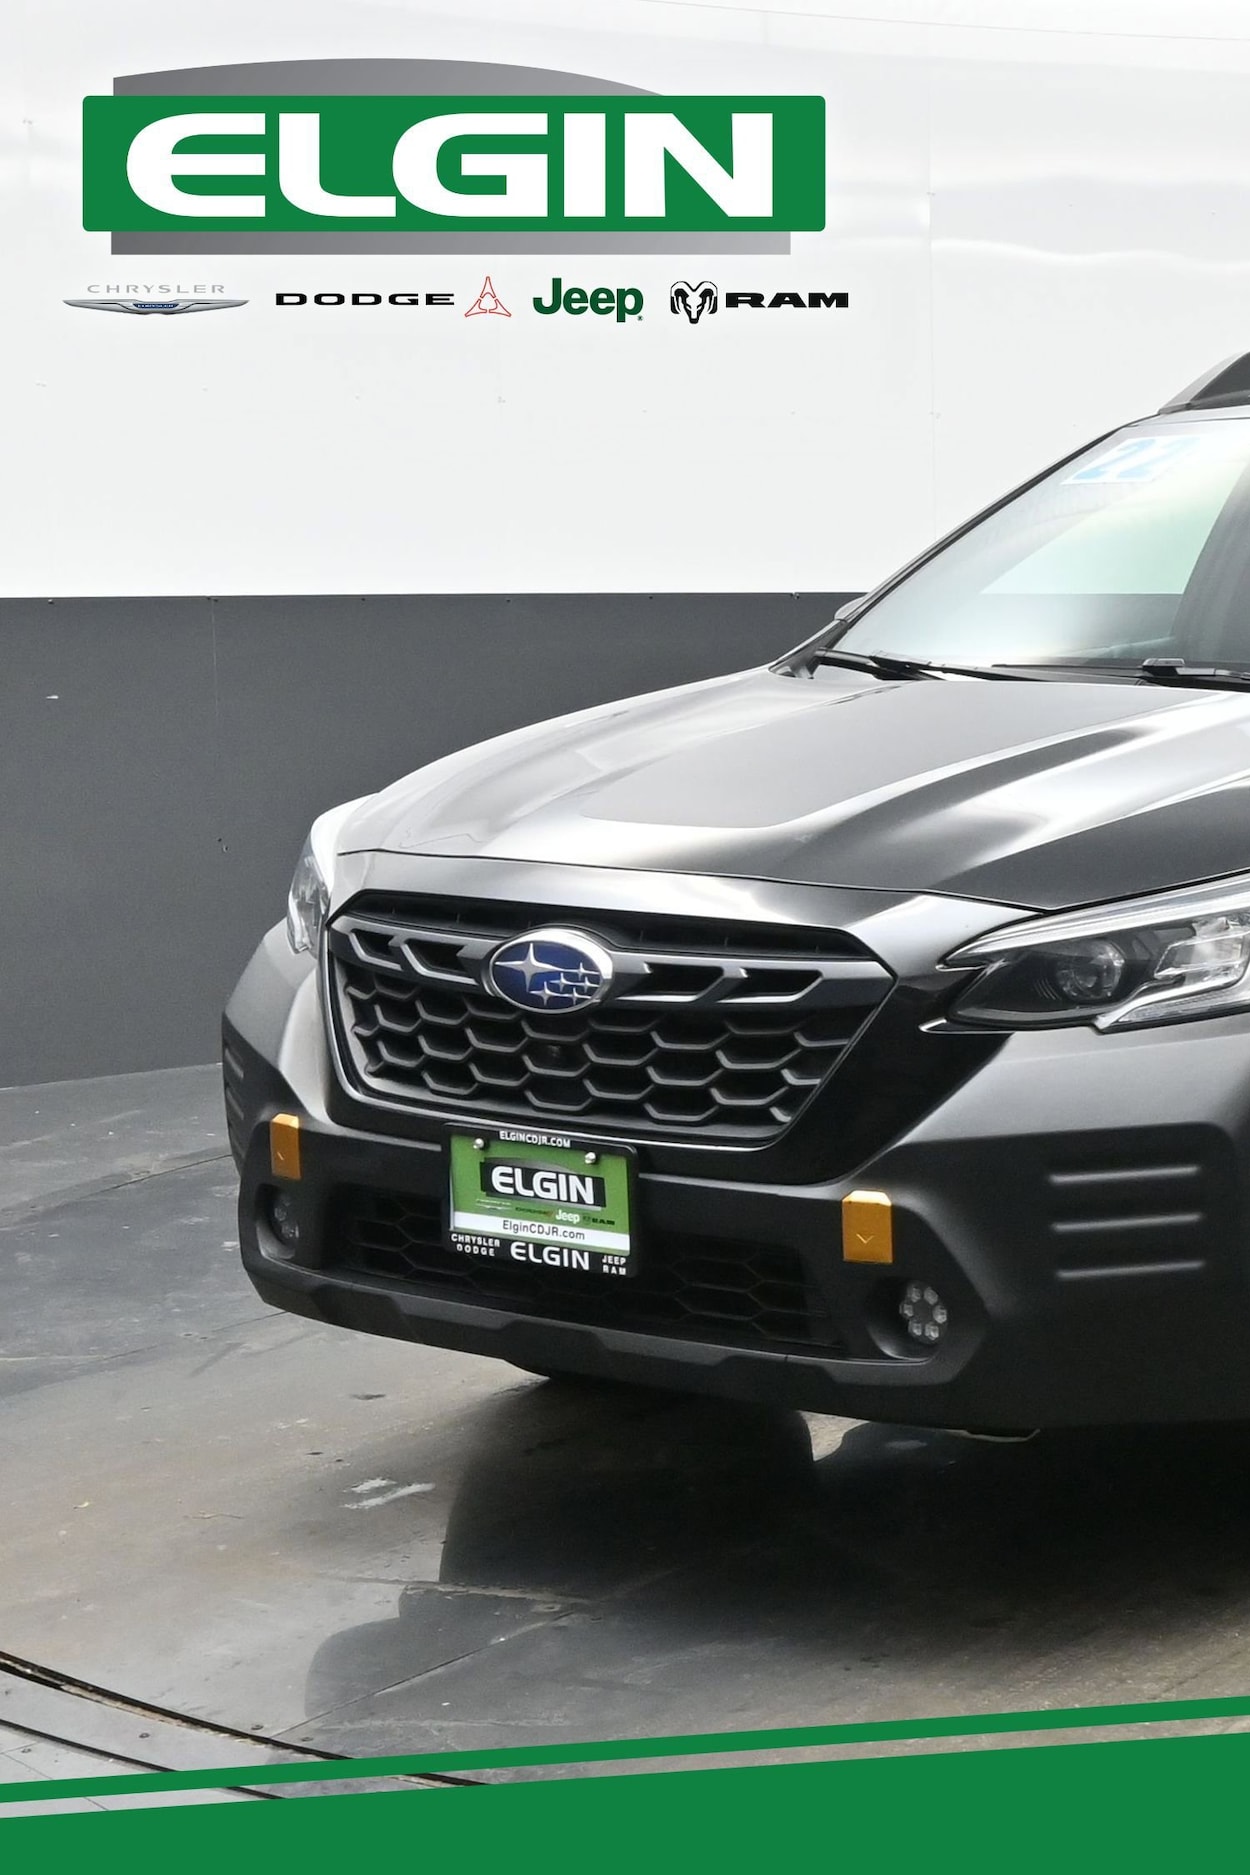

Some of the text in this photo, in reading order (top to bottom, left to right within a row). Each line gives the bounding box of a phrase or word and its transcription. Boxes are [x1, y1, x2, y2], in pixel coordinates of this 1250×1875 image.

[499, 1130, 571, 1148] ELGINCDJR.COM
[492, 1165, 594, 1204] ELGIN
[556, 1209, 580, 1224] Jeep
[502, 1220, 585, 1240] ElginCDJR.com
[451, 1234, 500, 1248] CHRYSLER
[457, 1244, 495, 1256] DODGE
[510, 1242, 589, 1270] ELGIN
[602, 1255, 626, 1265] JEEP
[603, 1265, 626, 1276] RAM
